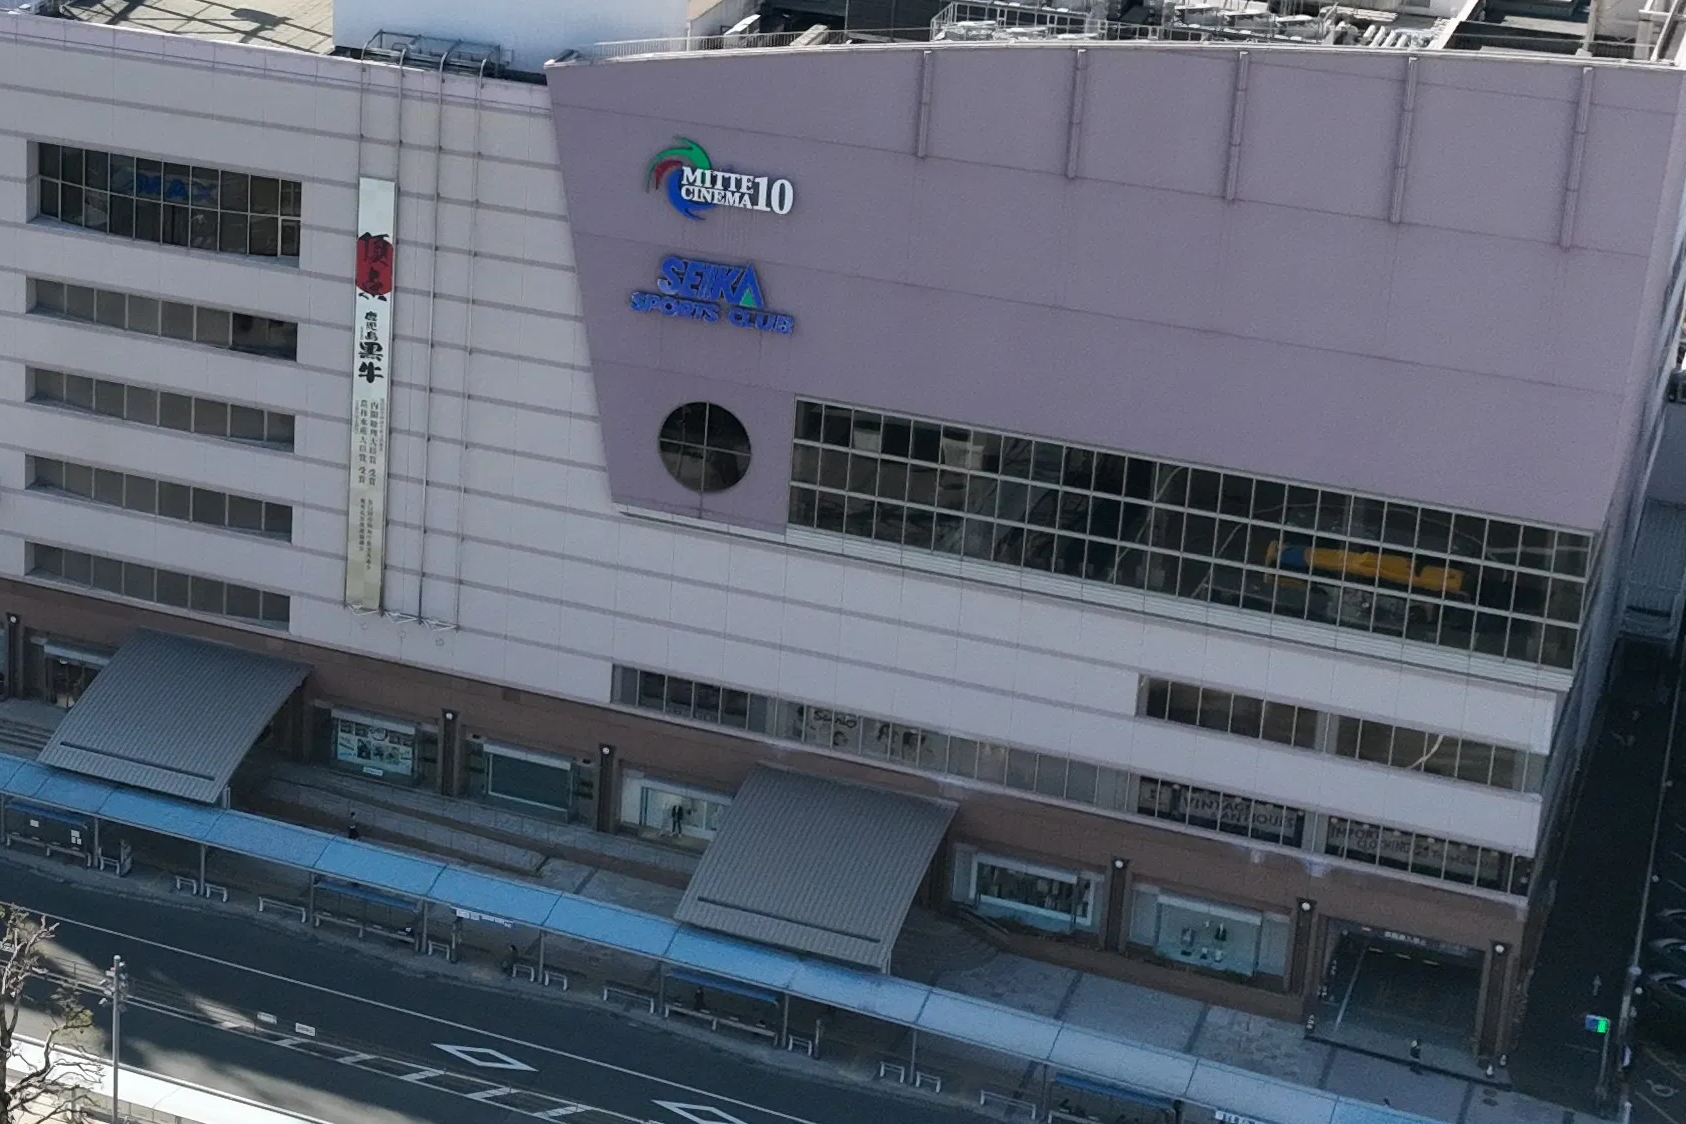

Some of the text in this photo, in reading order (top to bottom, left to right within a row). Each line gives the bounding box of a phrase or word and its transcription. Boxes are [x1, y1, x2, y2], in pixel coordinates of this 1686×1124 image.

[680, 185, 753, 210] CINEMA
[681, 166, 794, 215] MITTE 10
[630, 291, 795, 334] SPORTS CLUB
